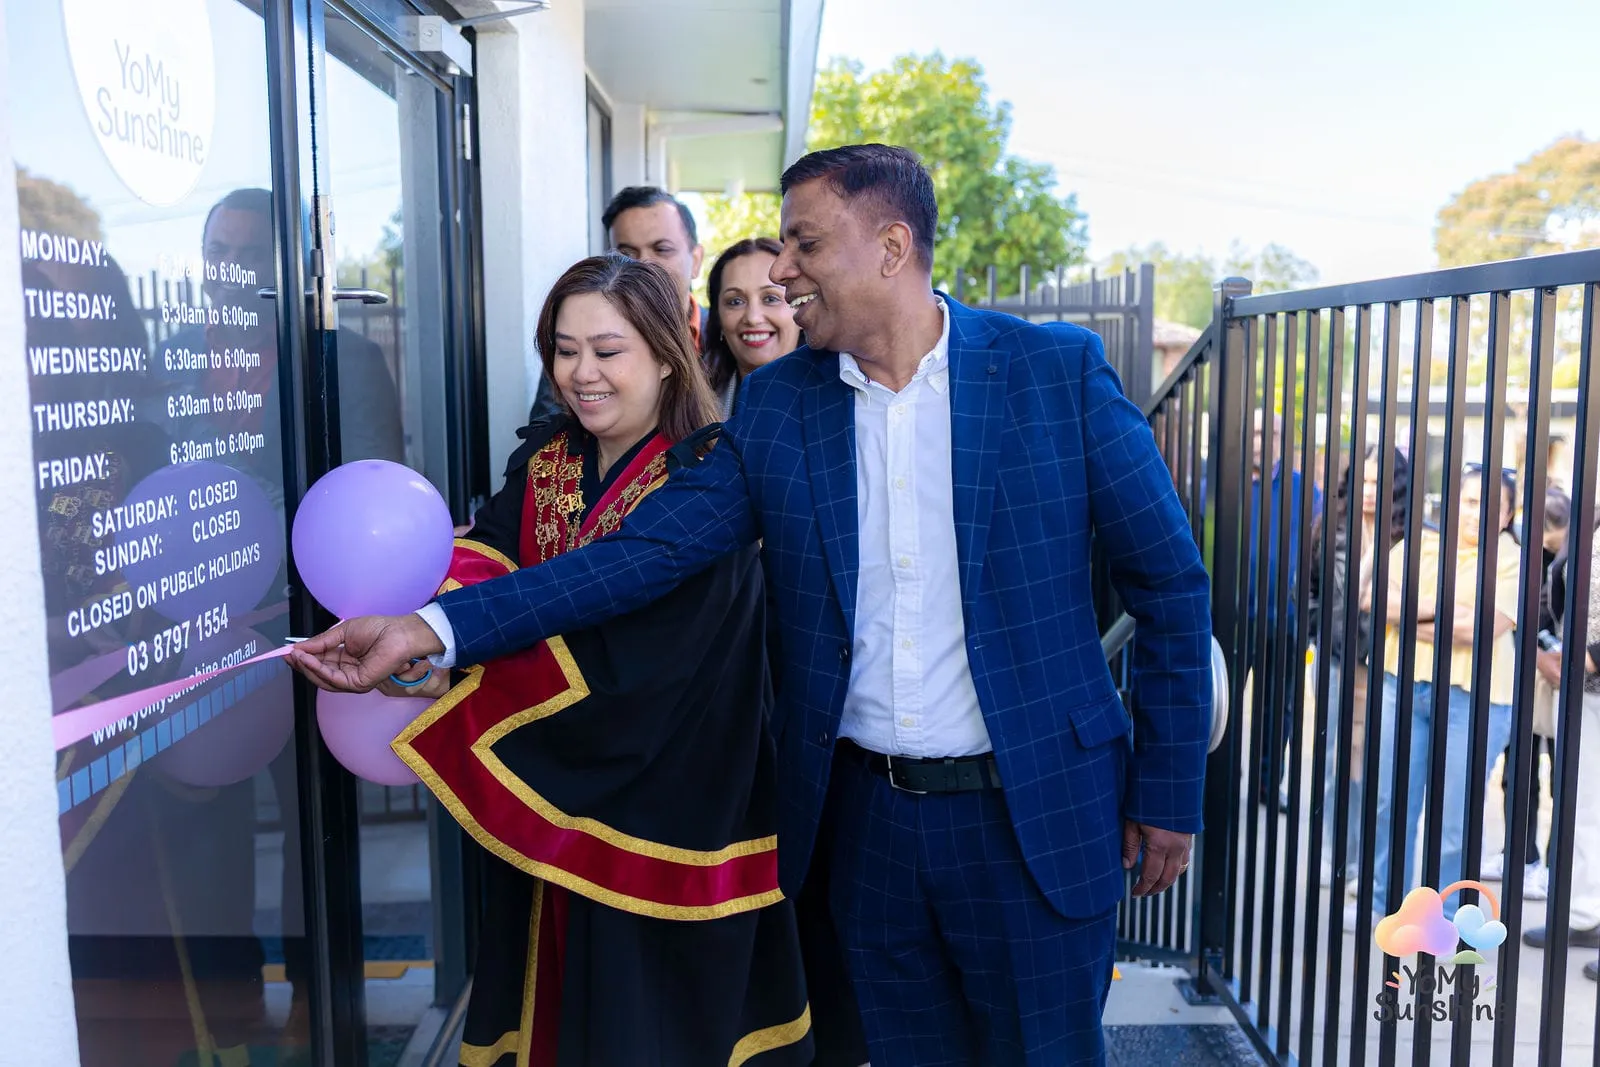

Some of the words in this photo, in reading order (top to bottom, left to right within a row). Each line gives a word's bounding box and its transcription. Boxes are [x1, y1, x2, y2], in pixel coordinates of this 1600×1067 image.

[114, 38, 180, 121] YoMy
[96, 86, 204, 165] Sunshine
[21, 229, 108, 267] MONDAY:
[205, 260, 217, 280] to
[220, 261, 256, 288] 6:00pm
[25, 288, 117, 320] TUESDAY:
[162, 301, 205, 325] 6:30am
[208, 304, 219, 325] to
[222, 305, 258, 331] 6:00pm
[29, 347, 147, 376] WEDNESDAY:
[164, 349, 208, 371] 6:30am
[210, 350, 221, 369] to
[224, 348, 260, 373] 6:00pm
[34, 398, 135, 433] THURSDAY:
[167, 395, 210, 418] 6:30am
[212, 393, 224, 412] to
[226, 390, 262, 413] 6:00pm
[38, 453, 110, 490] FRIDAY:
[170, 439, 213, 465] 6:30am
[215, 437, 226, 456] to
[229, 432, 265, 456] 6:00pm
[92, 495, 178, 538] SATURDAY:
[188, 479, 238, 511] CLOSED
[95, 534, 163, 576] SUNDAY:
[192, 510, 241, 544] CLOSED
[68, 592, 133, 637] CLOSED
[136, 581, 157, 610] ON
[161, 563, 206, 600] PUBLIC
[208, 543, 260, 581] HOLIDAYS
[127, 640, 149, 676] 03
[153, 619, 191, 664] 8797
[195, 602, 229, 643] 1554
